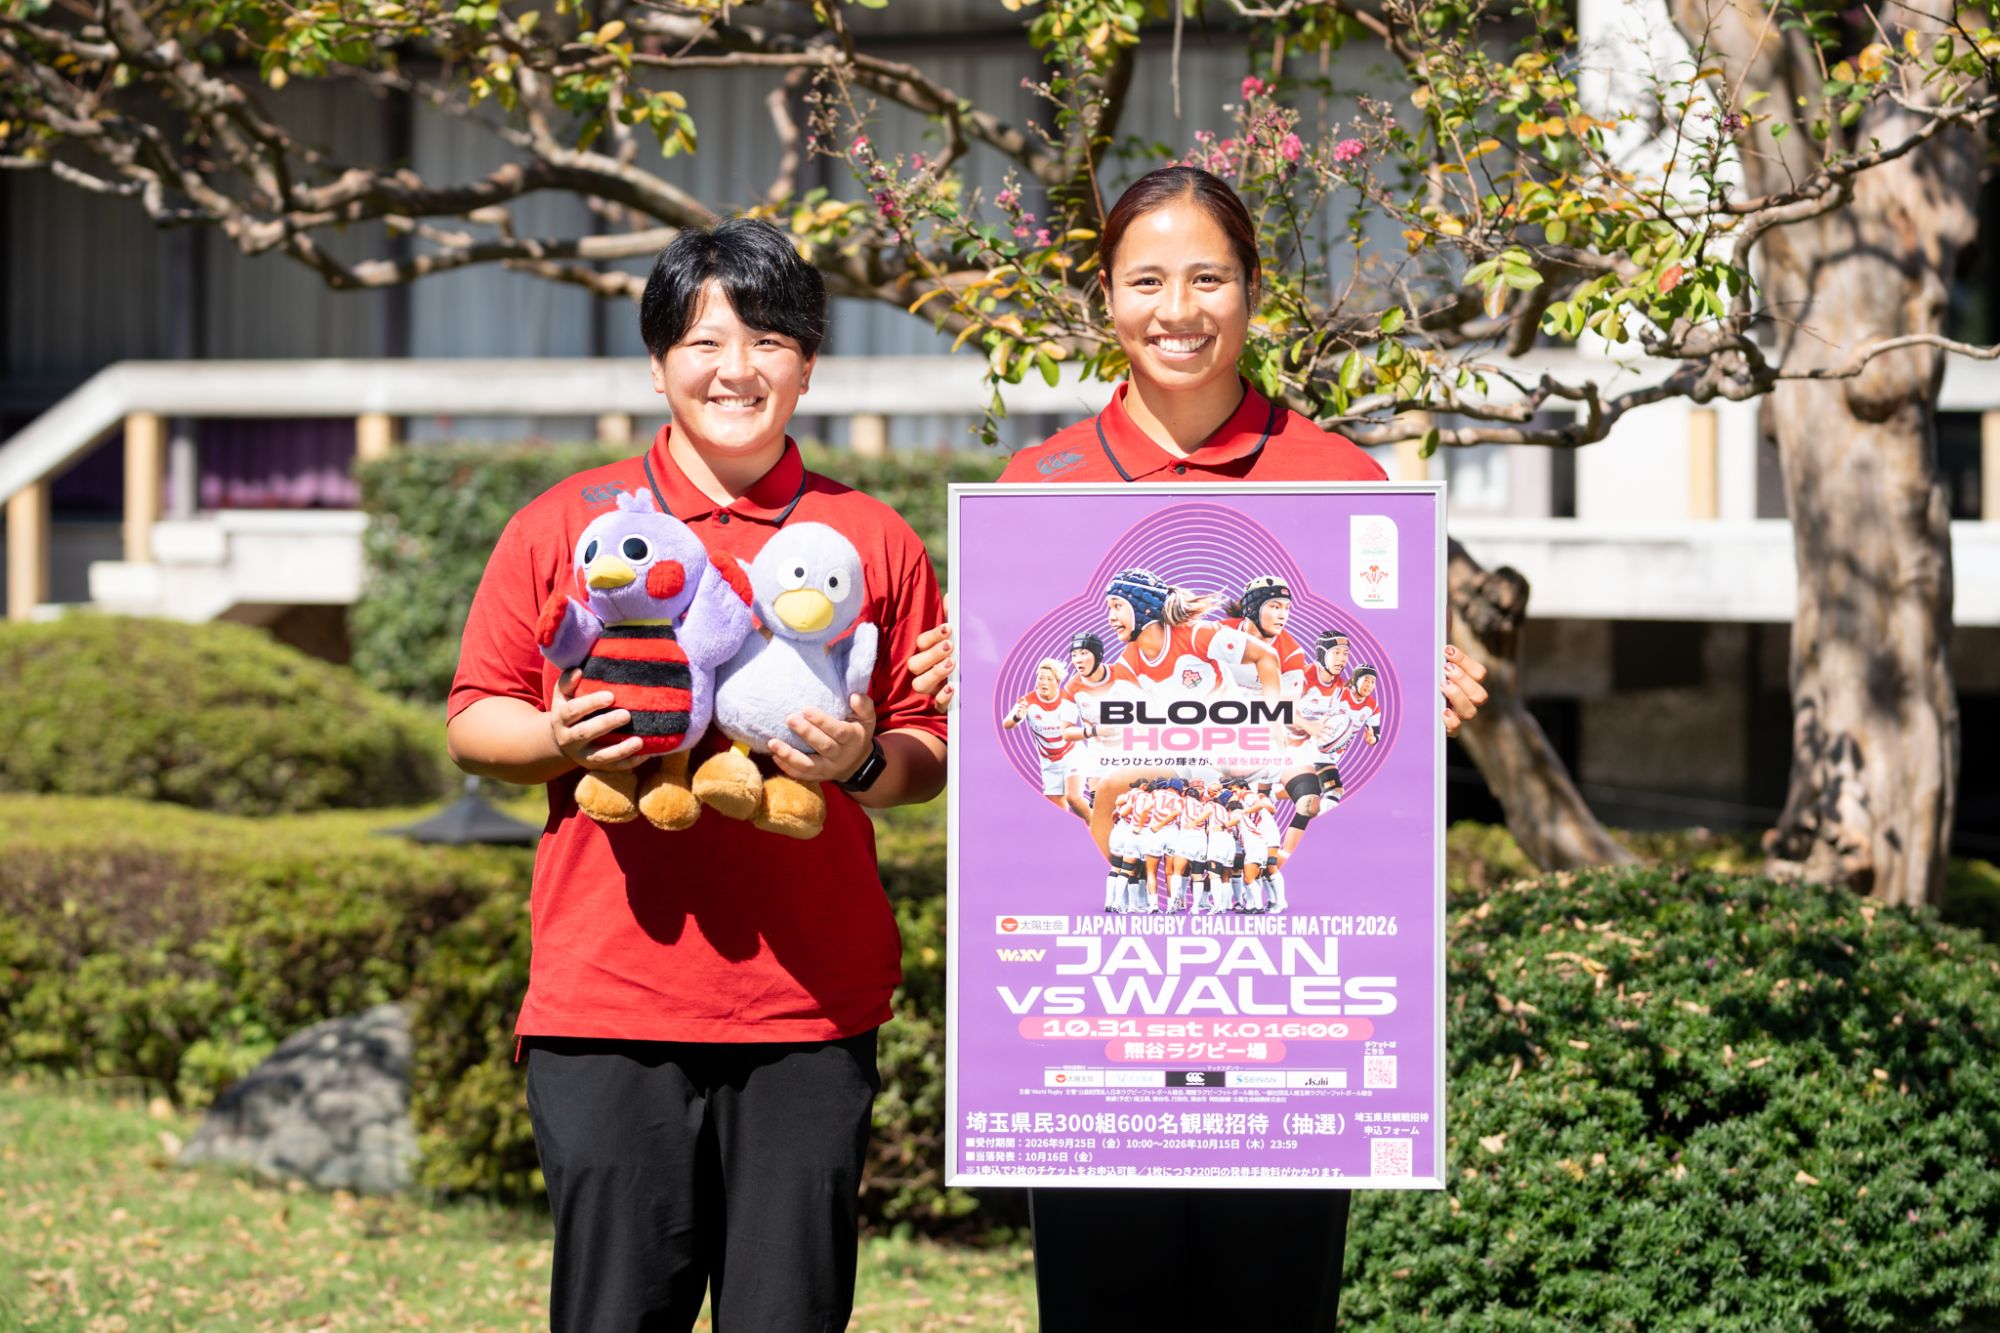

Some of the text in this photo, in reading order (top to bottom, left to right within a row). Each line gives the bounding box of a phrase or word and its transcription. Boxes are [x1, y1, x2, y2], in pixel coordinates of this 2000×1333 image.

[1100, 701, 1293, 725] BLOOM
[1123, 727, 1270, 751] HOPE
[1020, 920, 1063, 931] 太陽生命
[1072, 915, 1398, 936] JAPAN RUGBY CHALLENGE MATCH 2026
[1056, 936, 1338, 976] JAPAN
[1092, 976, 1398, 1015] WALES
[1043, 1020, 1349, 1038] 10.31 sat K.O 16:00
[1124, 1041, 1267, 1060] 熊谷ラグビー場
[1364, 1041, 1397, 1049] チケットは
[1354, 1112, 1429, 1122] 埼玉県民観戦招待
[1364, 1125, 1420, 1135] 申込フォーム
